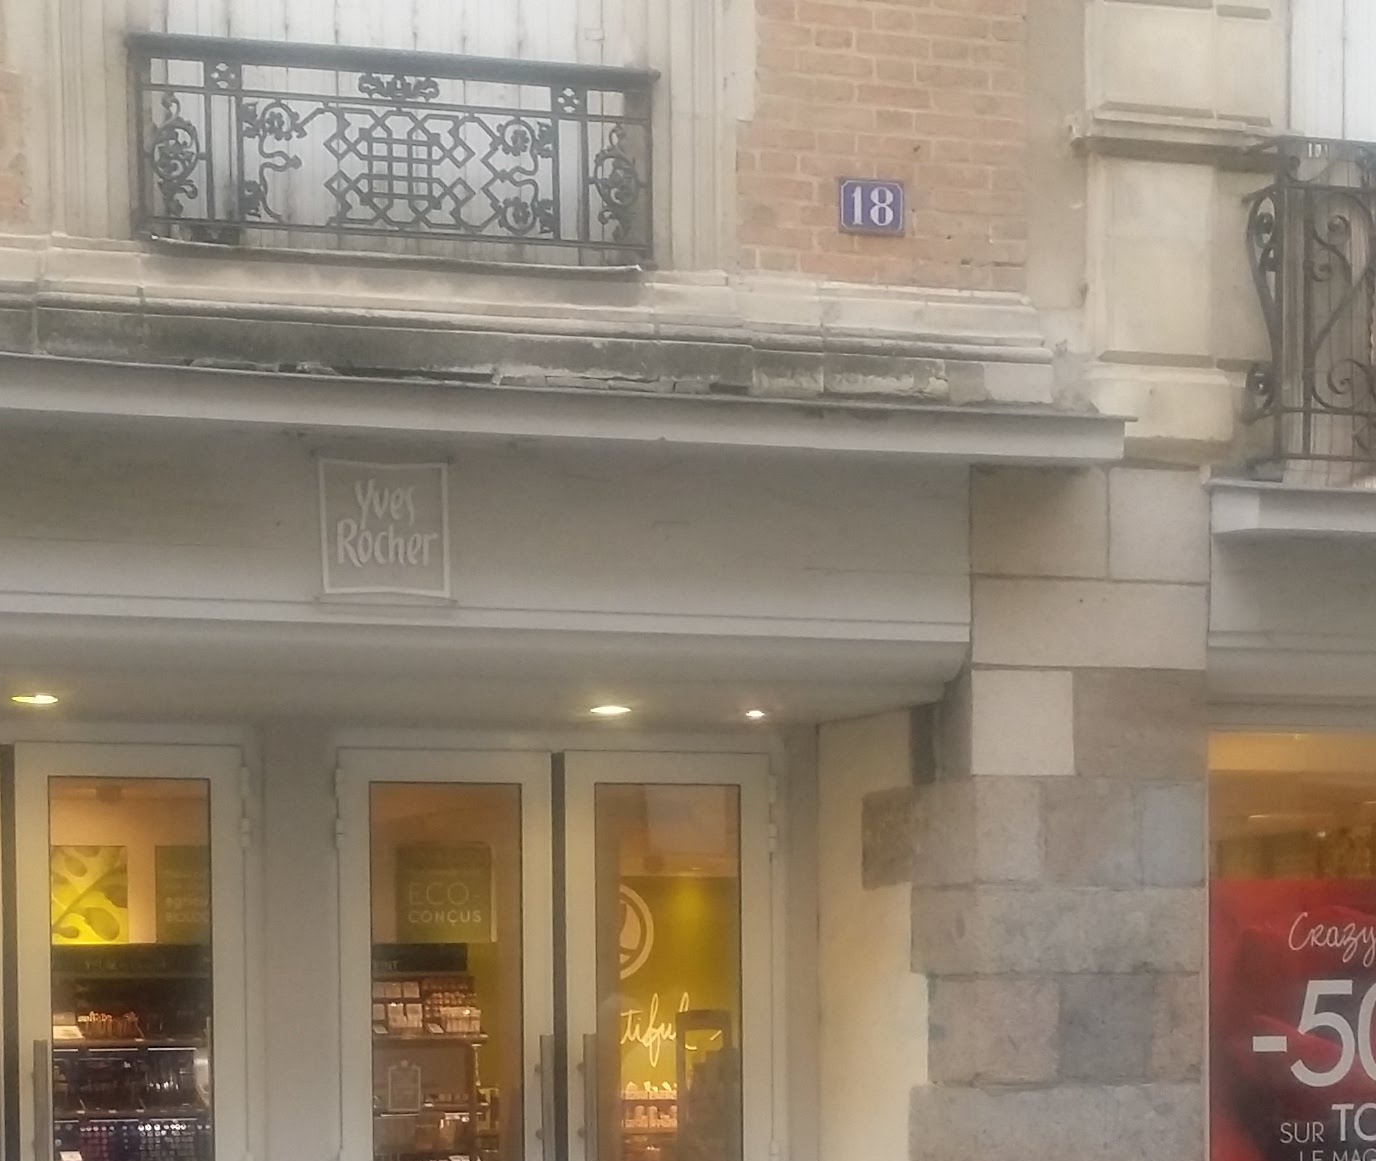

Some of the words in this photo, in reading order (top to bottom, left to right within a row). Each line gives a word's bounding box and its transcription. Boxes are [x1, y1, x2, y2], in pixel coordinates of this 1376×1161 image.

[852, 186, 894, 226] 18
[354, 479, 415, 530] Yves
[336, 518, 439, 567] Rocher
[408, 910, 482, 925] CONÇUS
[1280, 1122, 1324, 1143] SUR
